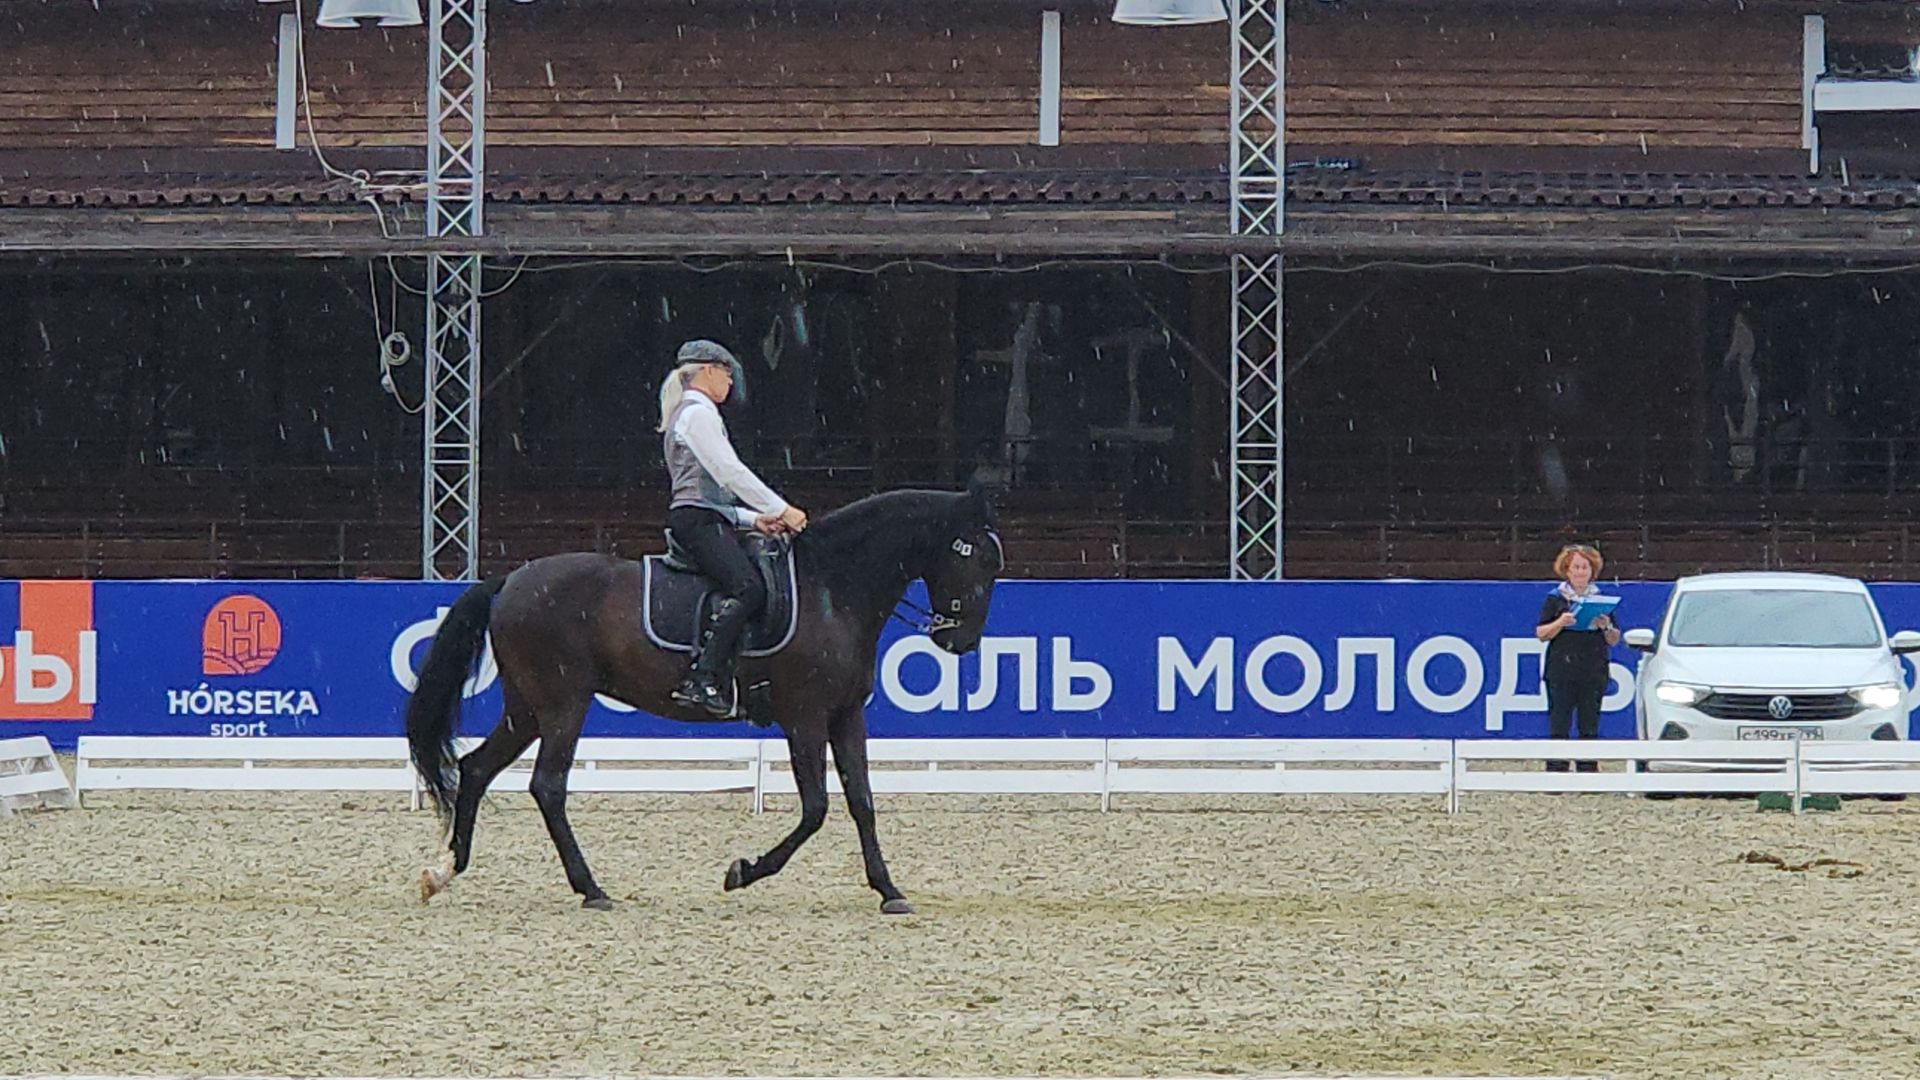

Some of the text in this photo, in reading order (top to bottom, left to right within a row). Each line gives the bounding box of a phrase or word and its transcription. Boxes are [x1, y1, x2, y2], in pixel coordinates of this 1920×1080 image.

[0, 630, 97, 704] ы
[167, 682, 319, 715] HÓRSEKA
[210, 720, 268, 737] sport
